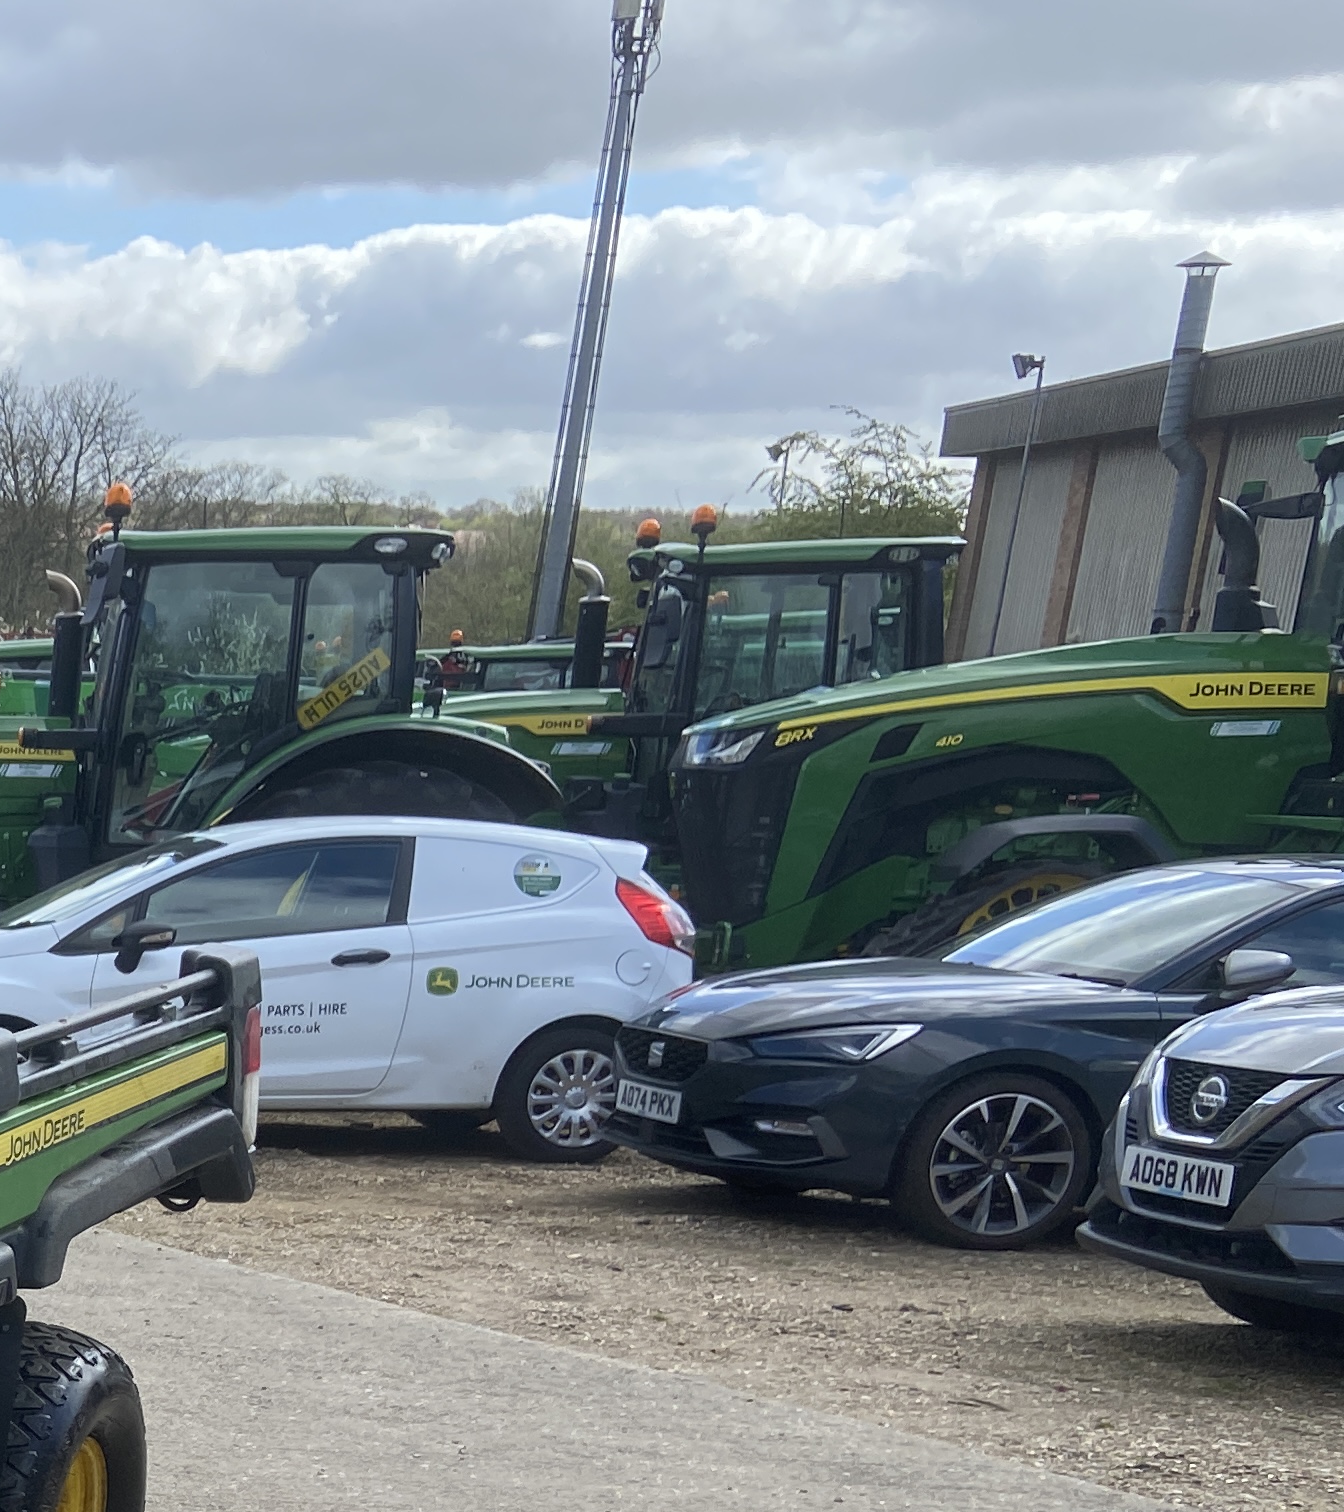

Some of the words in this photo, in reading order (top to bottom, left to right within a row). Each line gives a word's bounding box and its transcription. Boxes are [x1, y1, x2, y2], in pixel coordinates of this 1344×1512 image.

[338, 655, 381, 697] AU25
[1189, 682, 1243, 697] JOHN
[1249, 681, 1316, 696] DEERE
[537, 719, 572, 730] JOHN
[775, 726, 818, 747] 8RX
[935, 733, 964, 748] 410
[465, 974, 512, 989] JOHN
[516, 974, 575, 989] DEERE
[267, 1004, 305, 1017] PARTS
[318, 1002, 348, 1016] HIRE
[648, 1090, 676, 1118] PKX
[5, 1127, 42, 1162] JOHN
[43, 1109, 86, 1146] DEERE
[1181, 1162, 1224, 1199] KWN
